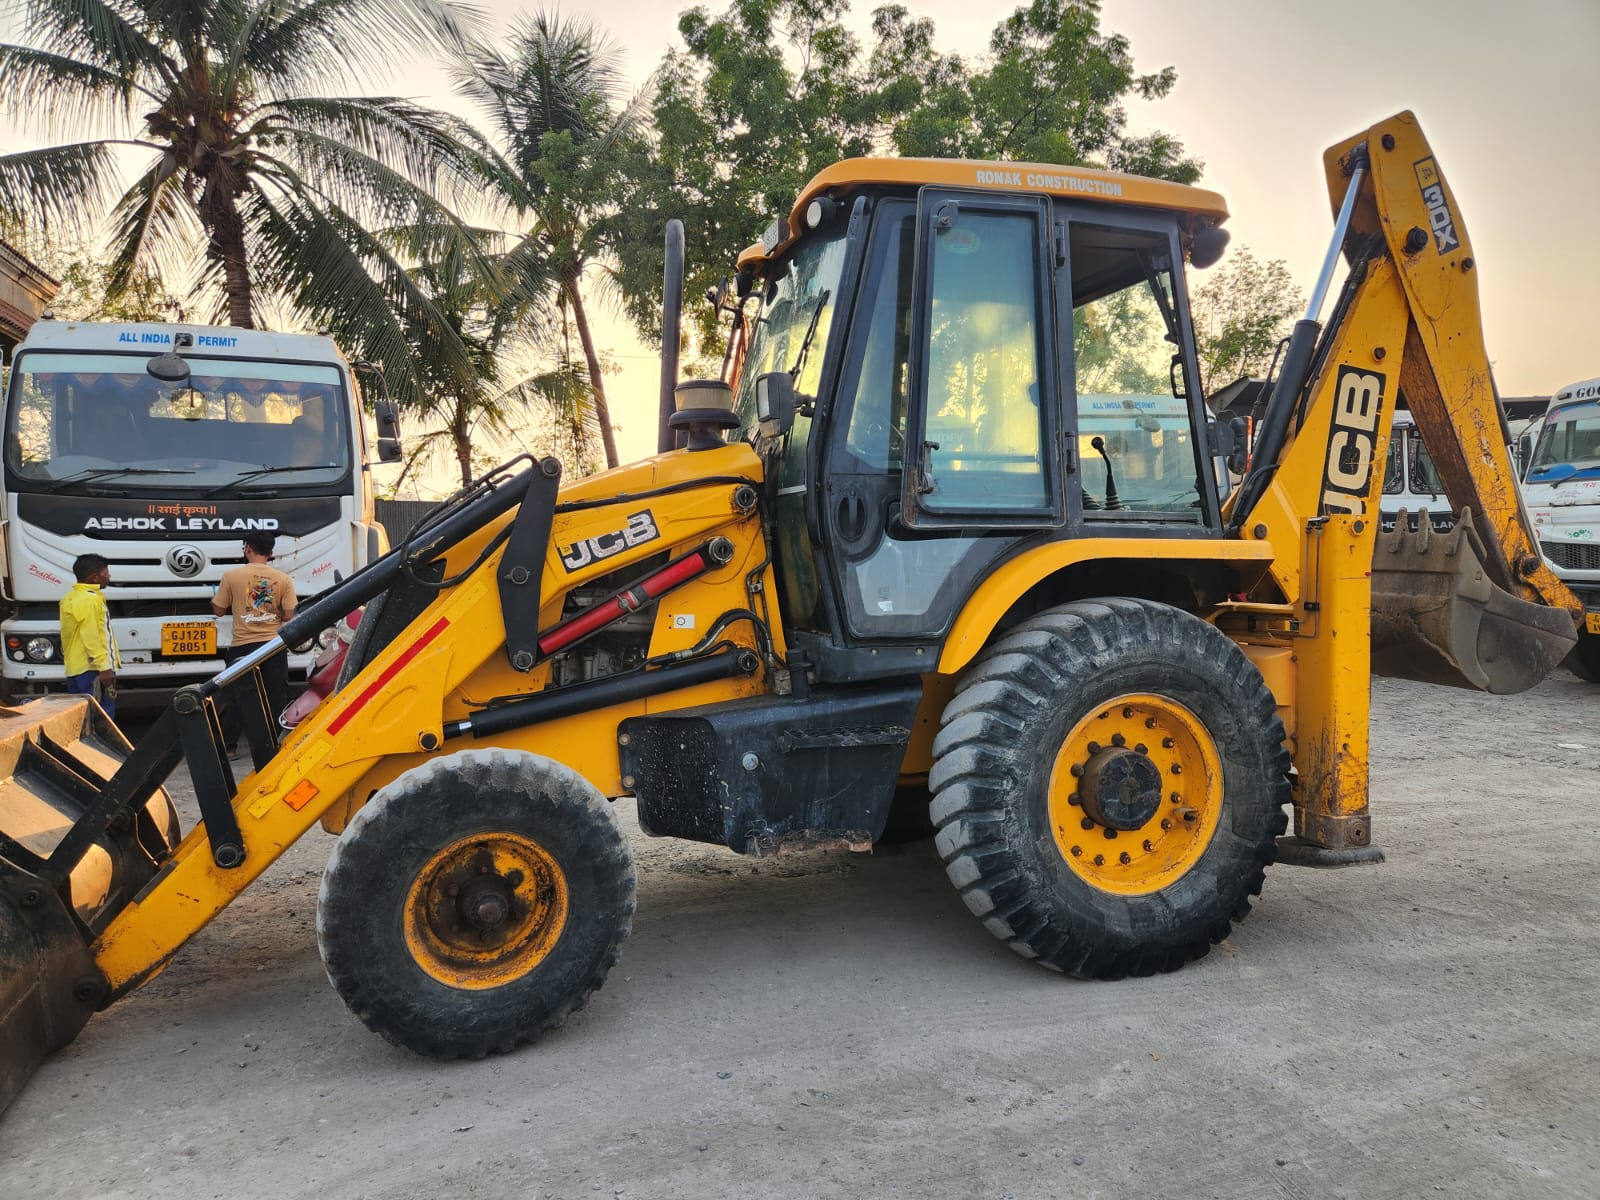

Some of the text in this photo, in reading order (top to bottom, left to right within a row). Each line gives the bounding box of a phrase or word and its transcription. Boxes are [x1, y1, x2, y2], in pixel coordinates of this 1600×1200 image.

[976, 170, 1123, 197] RONAK CONSTRUCTION
[1424, 185, 1458, 252] 3DX
[119, 332, 238, 347] ALL INDIA PERMIT
[1324, 372, 1380, 515] JCB
[84, 517, 279, 530] ASHOK LEYLAND
[564, 513, 657, 569] JCB
[171, 630, 207, 641] GJ12B
[172, 642, 207, 652] Z8051
